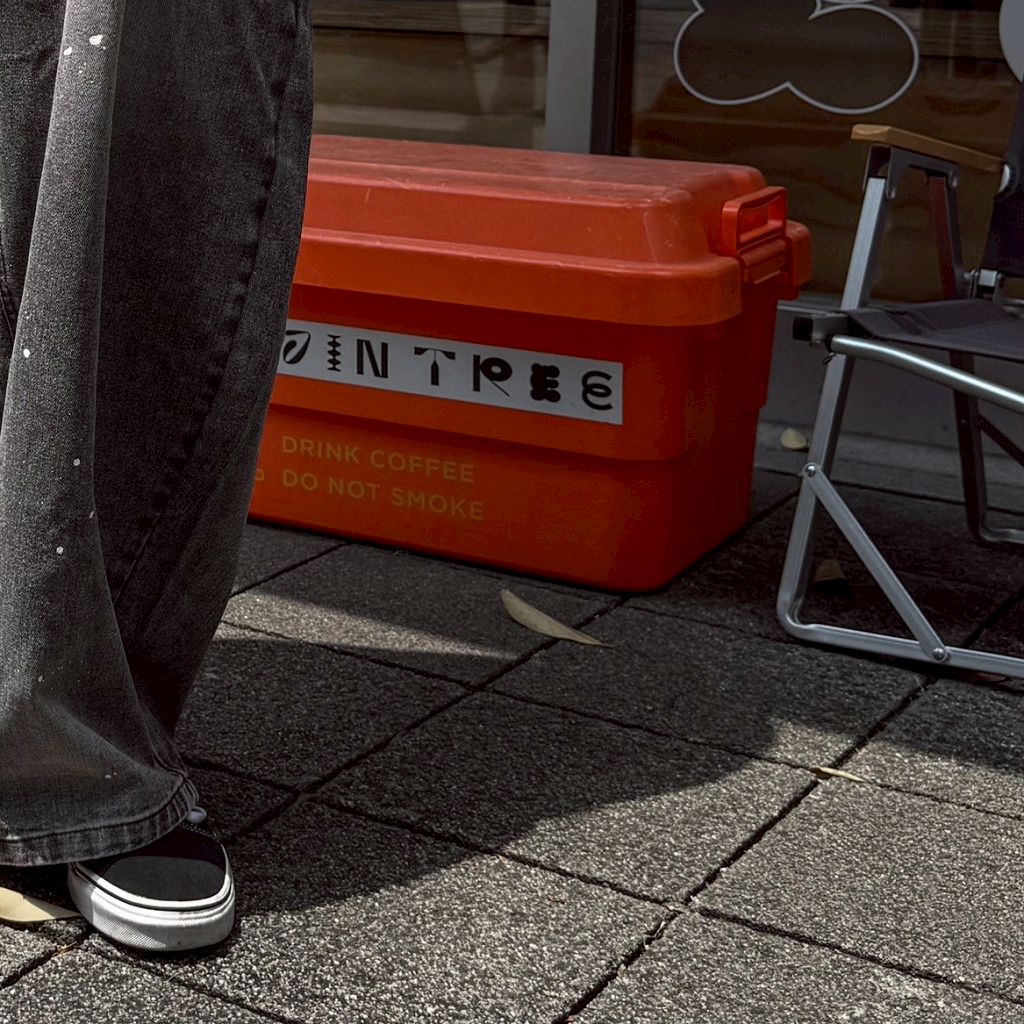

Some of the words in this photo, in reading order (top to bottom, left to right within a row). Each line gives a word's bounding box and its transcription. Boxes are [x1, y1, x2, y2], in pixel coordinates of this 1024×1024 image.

[282, 436, 359, 464] DRINK
[370, 450, 475, 483] COFFEE
[282, 469, 318, 491] DO
[328, 477, 381, 501] NOT
[391, 487, 485, 521] SMOKE
